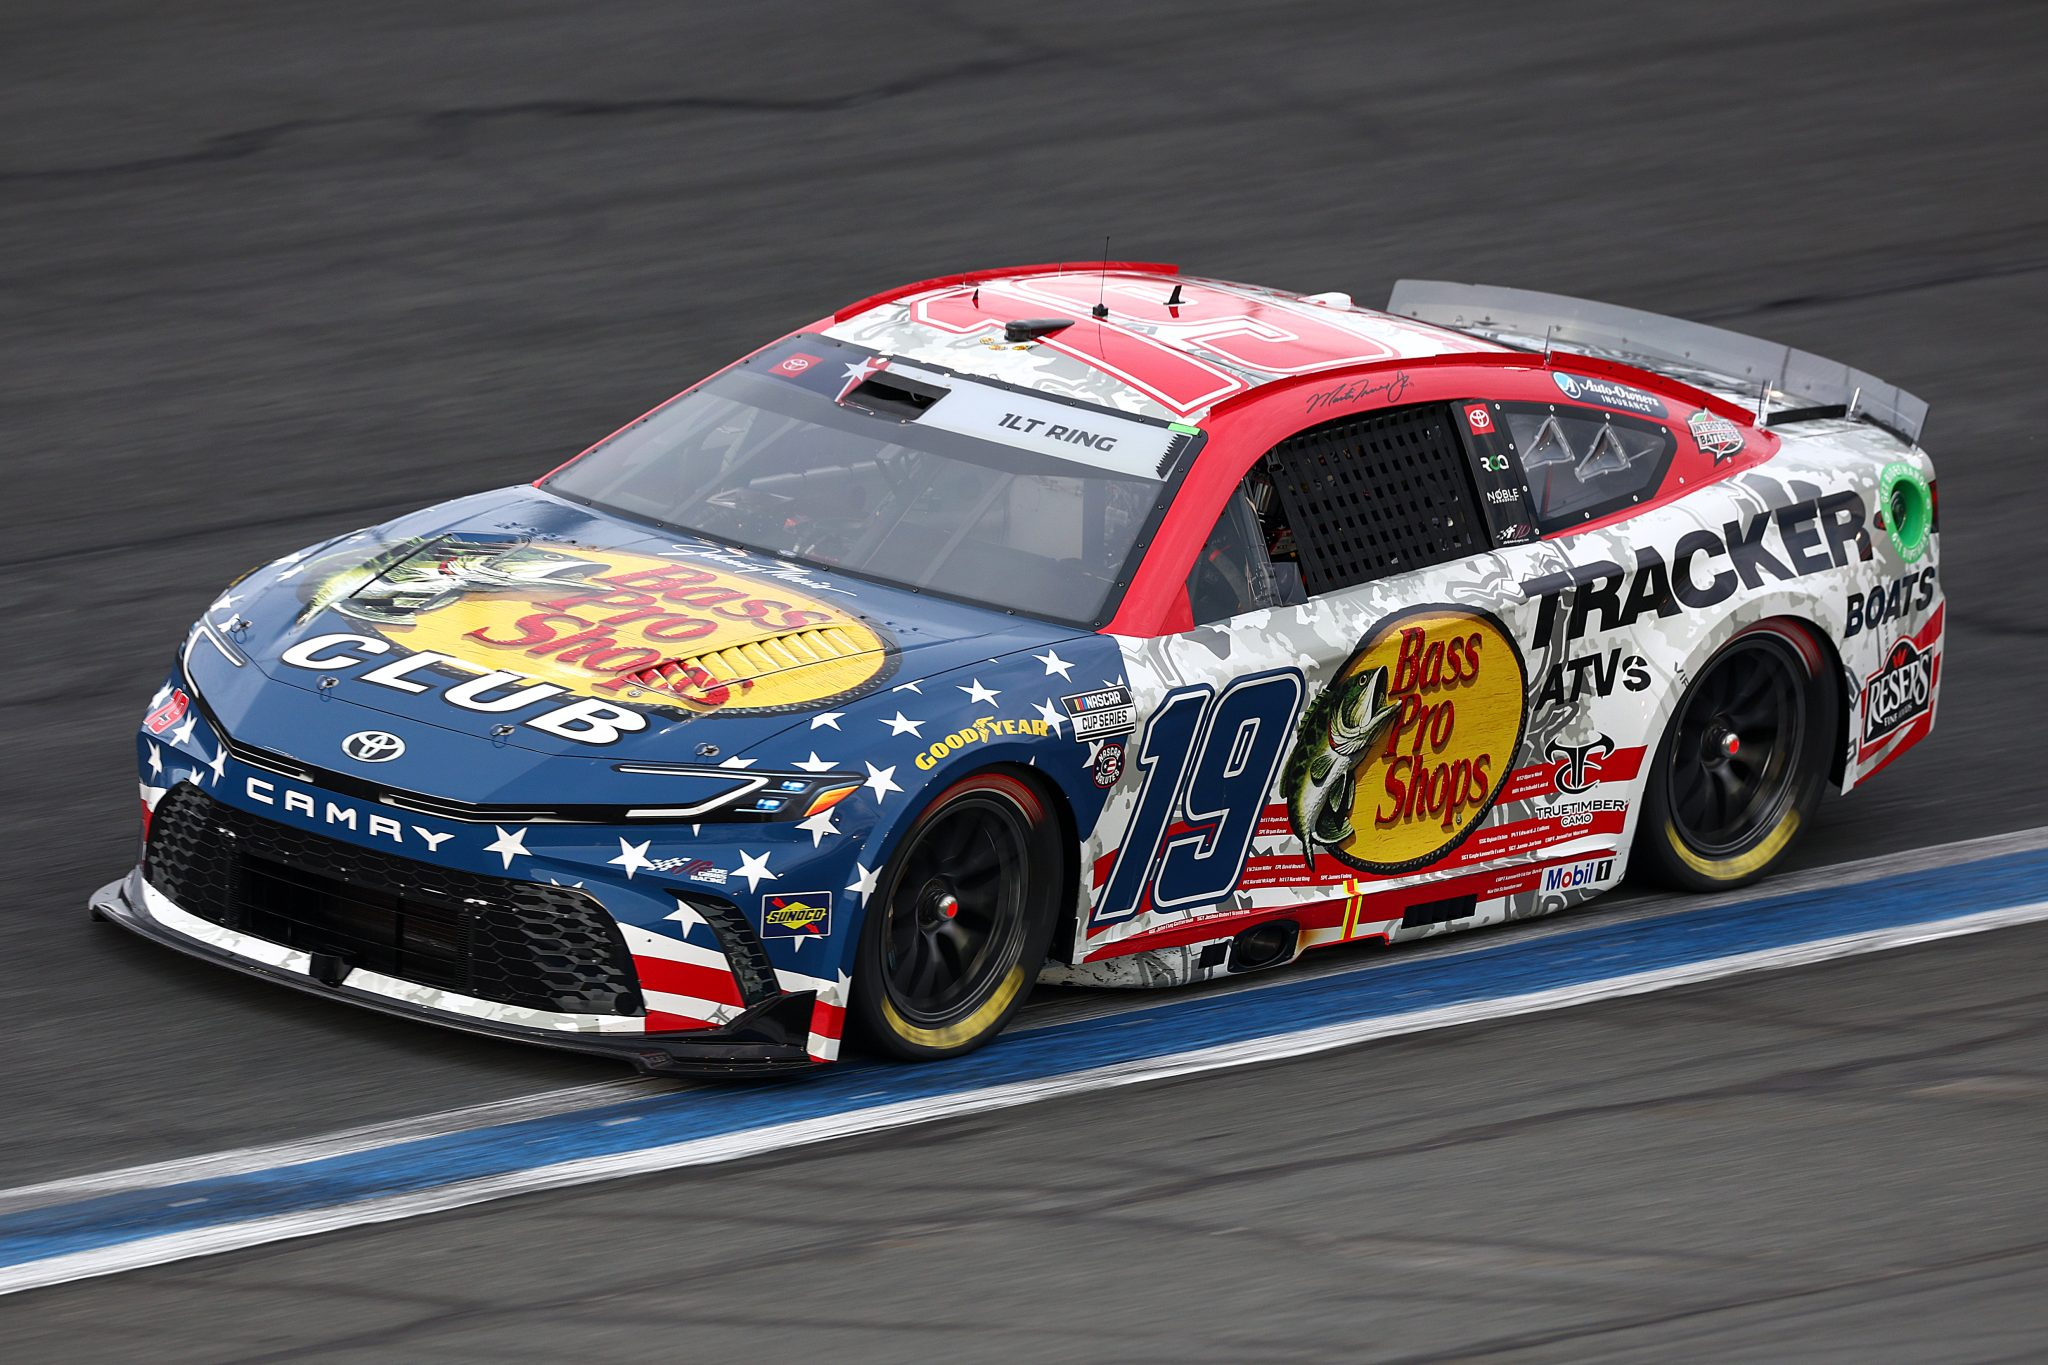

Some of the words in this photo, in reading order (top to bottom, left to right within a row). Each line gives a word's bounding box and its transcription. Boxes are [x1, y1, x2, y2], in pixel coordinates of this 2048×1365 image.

[1580, 379, 1660, 407] Auto-Owners
[1601, 394, 1652, 413] INSURANCE
[998, 413, 1046, 433] 1LT
[1044, 424, 1118, 452] RING
[1693, 421, 1737, 433] INTERSTATE
[1701, 431, 1741, 445] BATTERIES
[1519, 489, 1874, 651] TRACKER
[593, 562, 833, 631] Bass
[1844, 566, 1935, 638] BOATS
[532, 585, 719, 646] Pro
[1388, 626, 1483, 696] Bass
[280, 631, 652, 748] CLUB
[1086, 690, 1121, 710] NASCAR
[1082, 715, 1098, 730] CUP
[1098, 710, 1128, 728] SERIES
[1381, 693, 1455, 759] Pro
[914, 716, 1049, 771] GOODYEAR
[1098, 746, 1122, 763] NASCAR
[1095, 769, 1120, 785] SALUTES
[1374, 753, 1492, 832] Shops
[247, 777, 455, 852] CAMRY
[1087, 666, 1306, 929] 19
[1536, 800, 1625, 820] TRUETIMBER
[1562, 814, 1592, 827] CAMO
[1546, 862, 1595, 891] Mobil
[770, 908, 826, 924] SUNOCO
